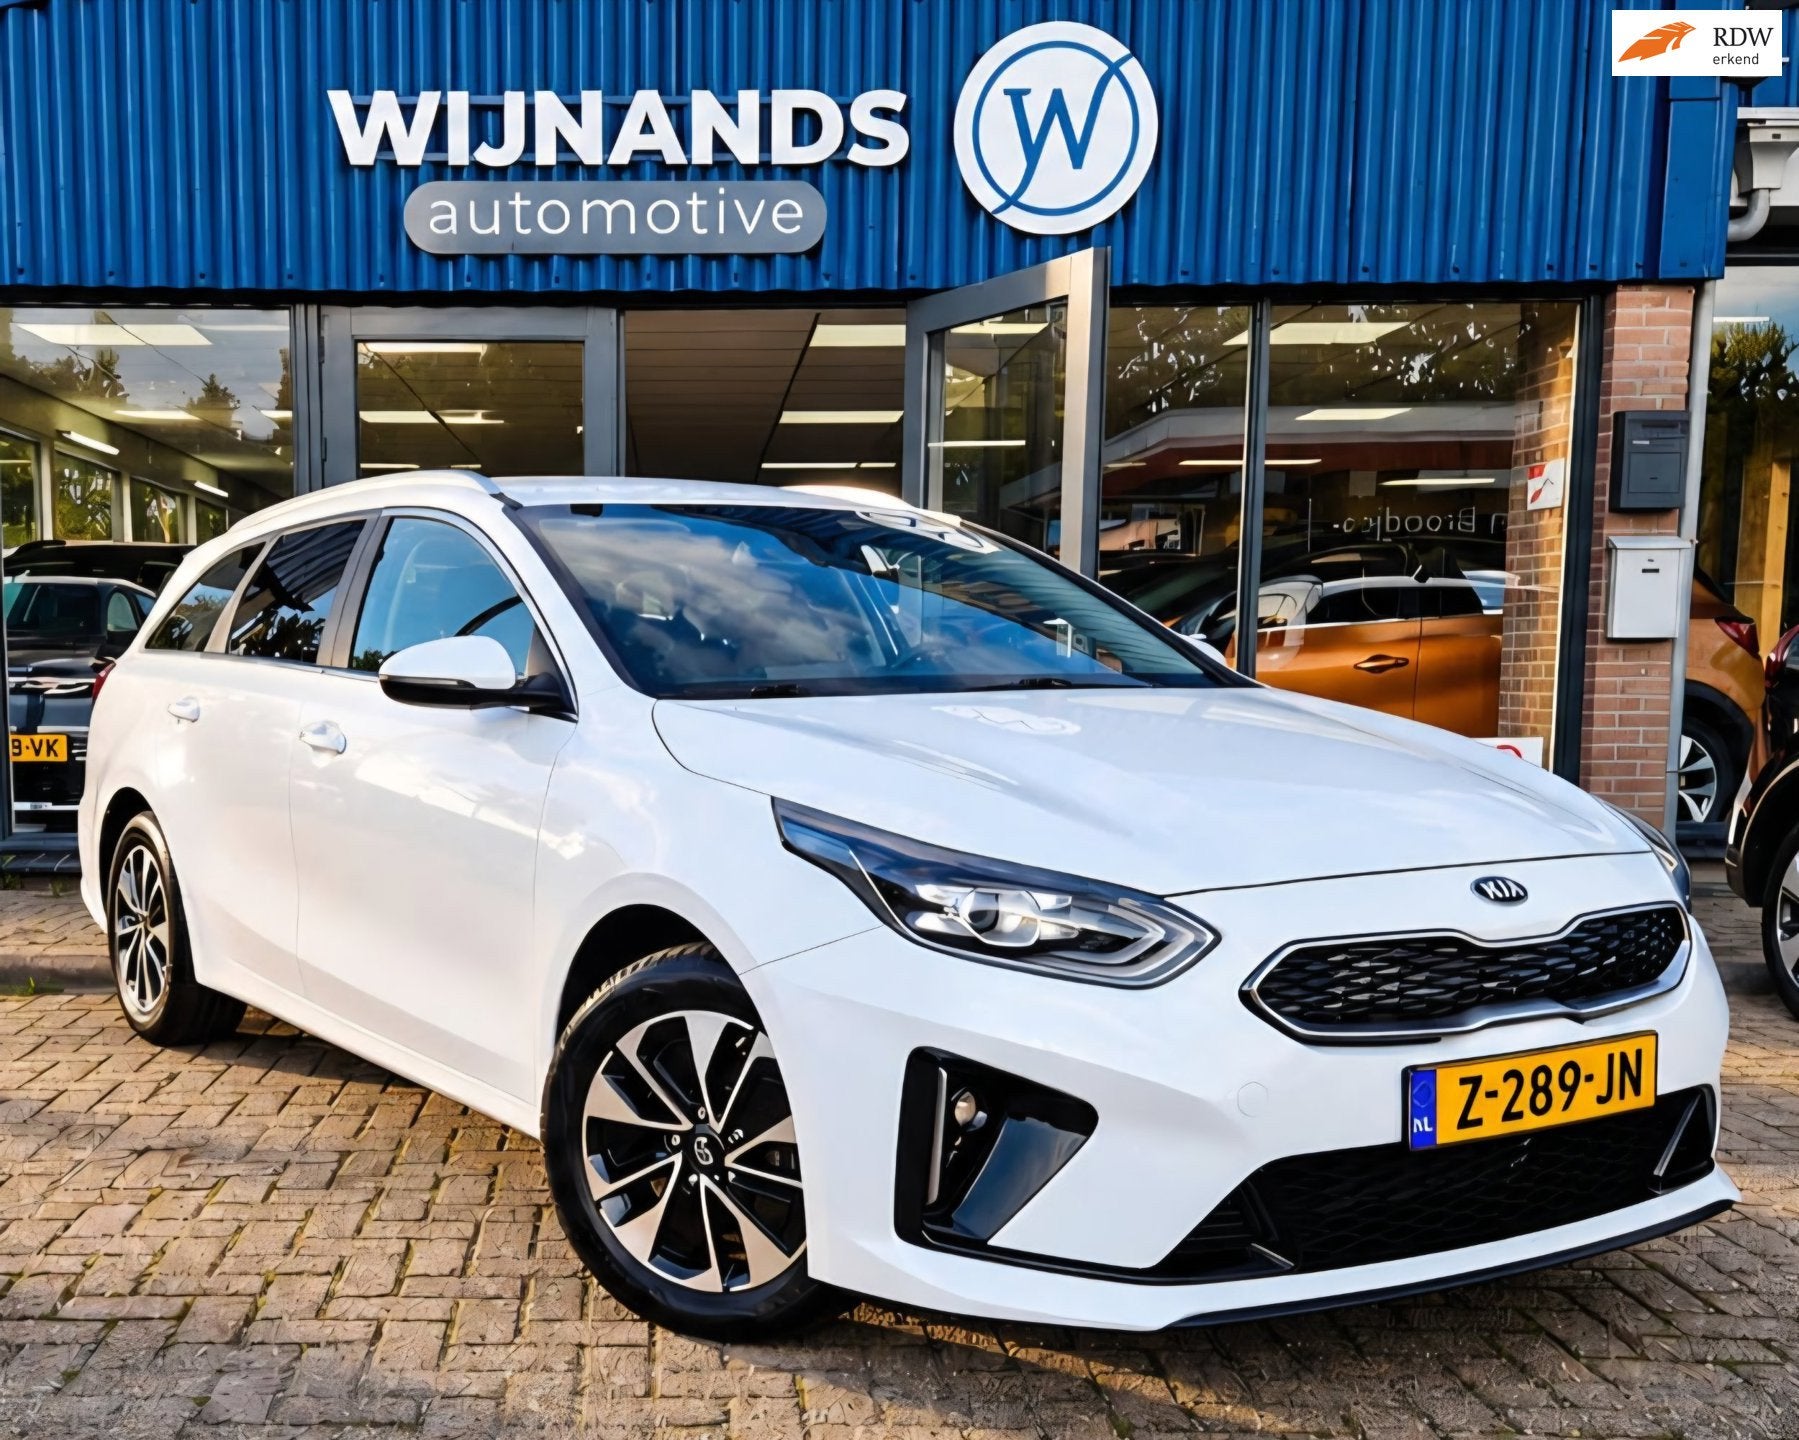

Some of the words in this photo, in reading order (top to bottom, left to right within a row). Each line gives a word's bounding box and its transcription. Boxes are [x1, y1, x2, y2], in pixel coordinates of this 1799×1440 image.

[327, 89, 910, 168] WIJNANDS
[428, 187, 804, 236] automotive
[1480, 879, 1525, 899] KIA
[1456, 1048, 1643, 1131] Z-289-JN
[1413, 1116, 1433, 1133] NL
